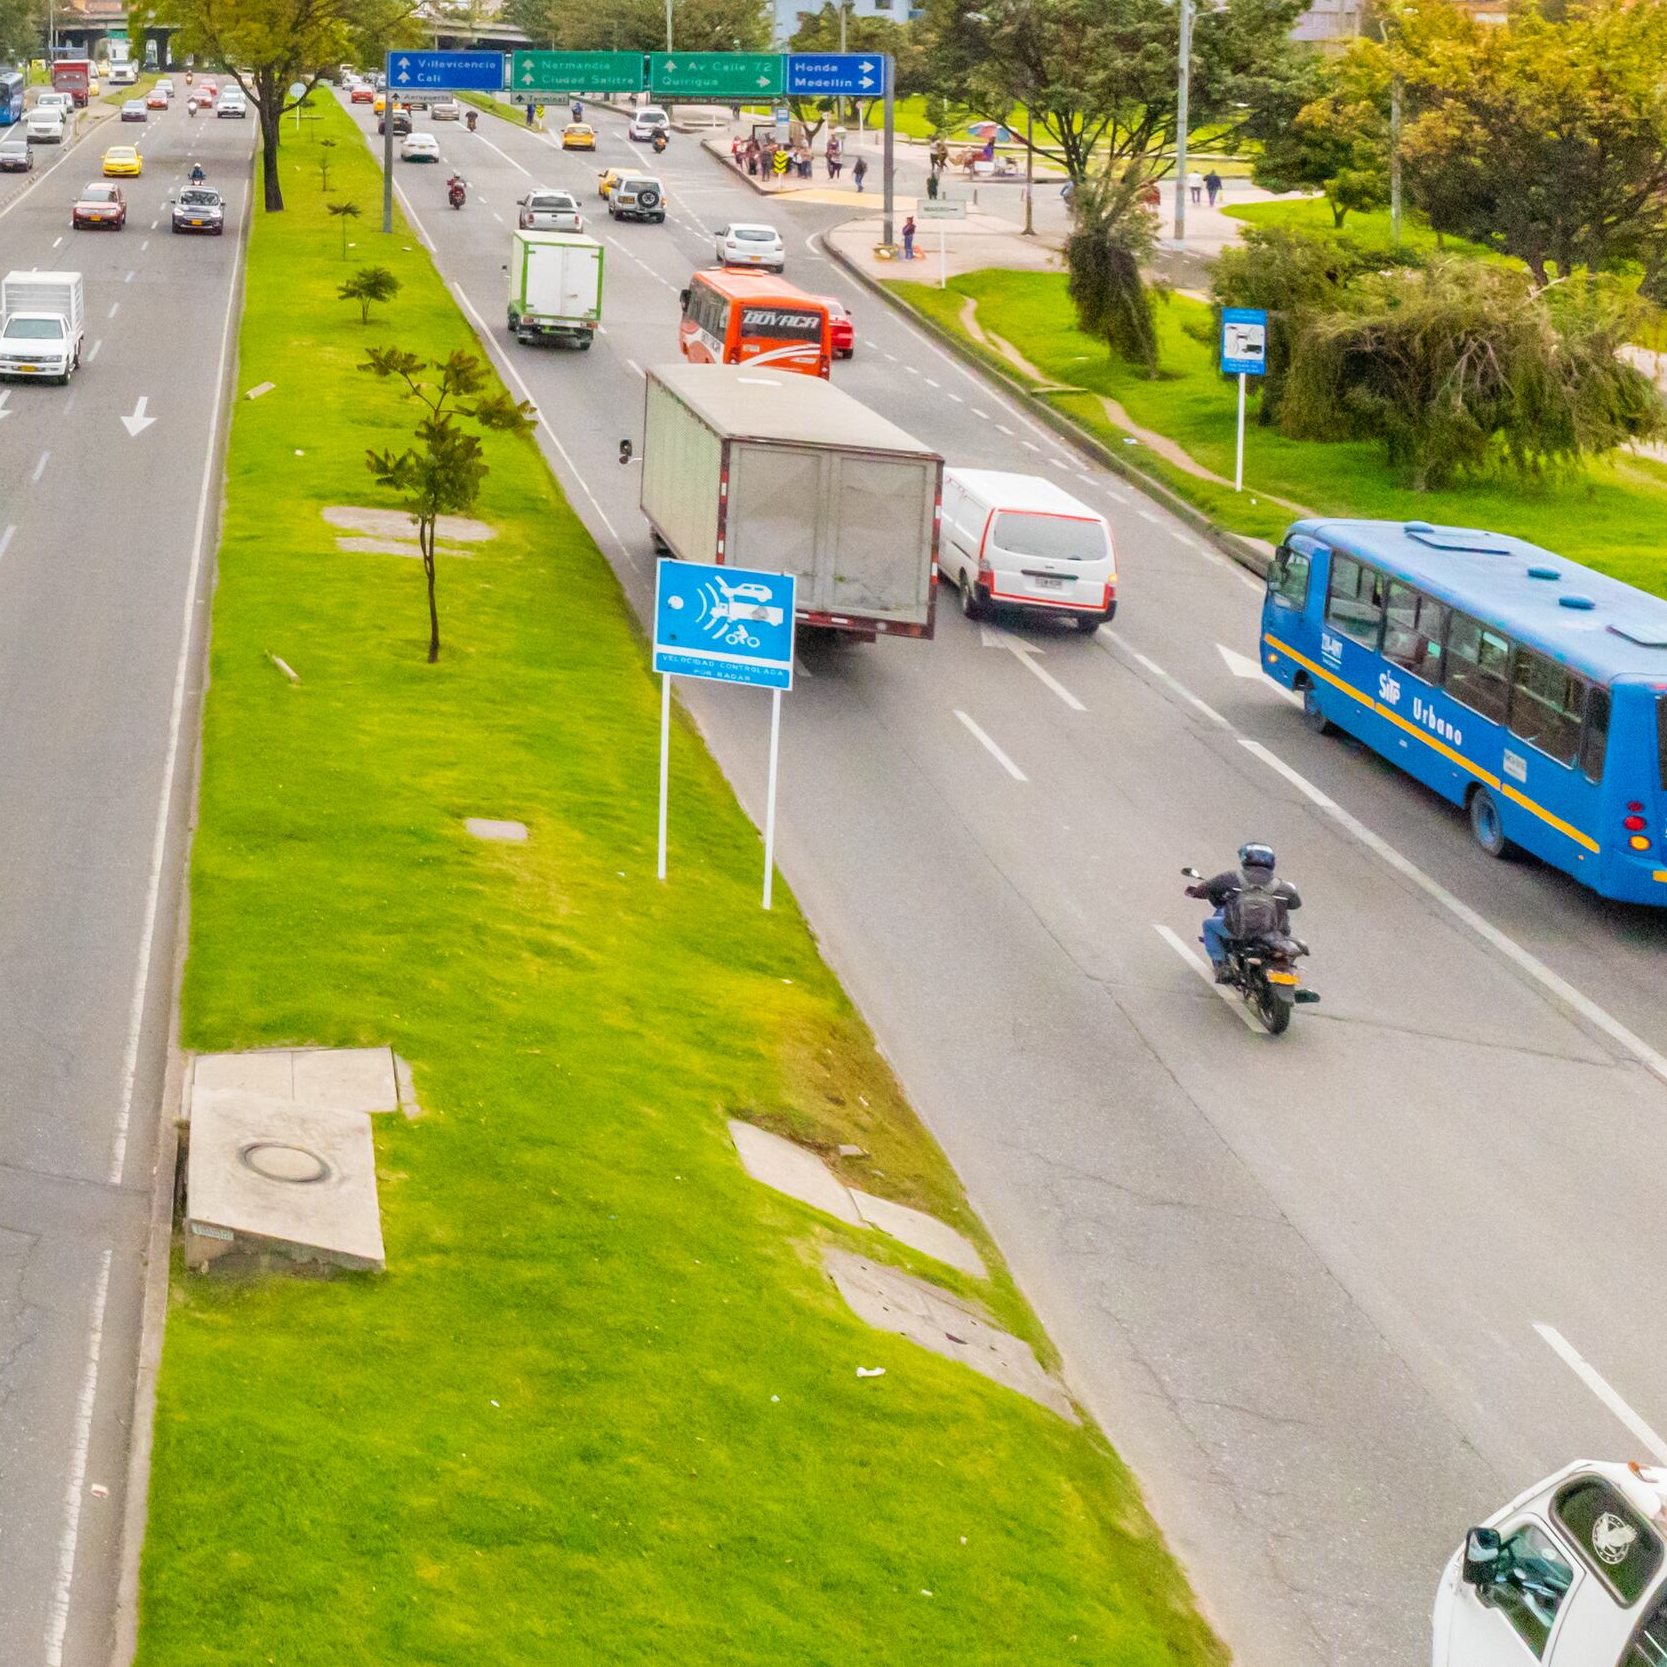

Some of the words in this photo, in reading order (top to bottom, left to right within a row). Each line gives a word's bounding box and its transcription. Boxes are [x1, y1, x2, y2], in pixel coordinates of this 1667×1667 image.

[417, 59, 496, 70] Villavicencio
[688, 62, 705, 72] Av
[712, 62, 746, 72] Calle
[794, 62, 838, 72] Honda
[417, 73, 441, 83] Cali
[541, 74, 585, 85] Ciudad
[591, 74, 634, 86] Salitre
[528, 95, 566, 104] Terminal
[743, 312, 820, 329] BOYACA
[662, 654, 715, 668] VELOCIDAD
[720, 661, 784, 677] CONTROLADA
[693, 669, 712, 677] POR
[717, 672, 751, 682] RADAR
[1413, 697, 1463, 746] Urbano
